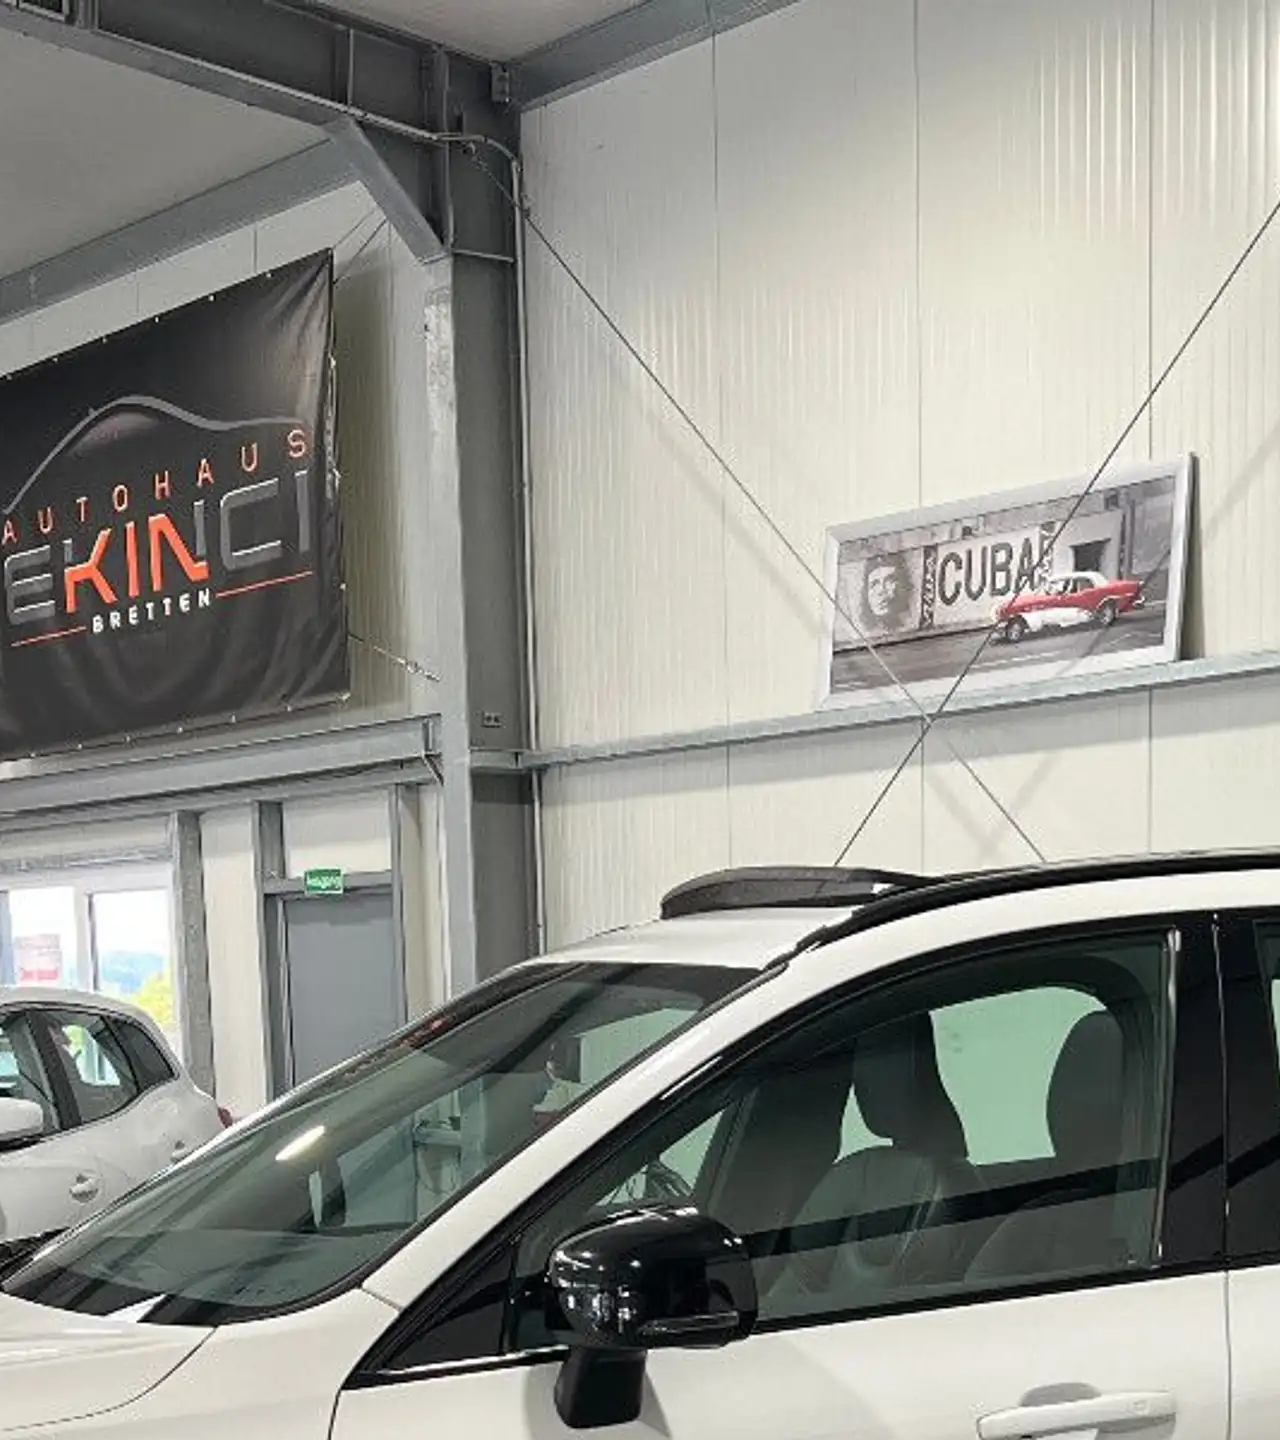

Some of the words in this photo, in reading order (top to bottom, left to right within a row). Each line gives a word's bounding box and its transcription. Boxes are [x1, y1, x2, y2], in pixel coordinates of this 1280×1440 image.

[2, 430, 308, 544] AUTOHAUS
[4, 470, 310, 624] EKINCI
[938, 537, 1042, 606] CUBA
[91, 588, 212, 633] BRETTEN
